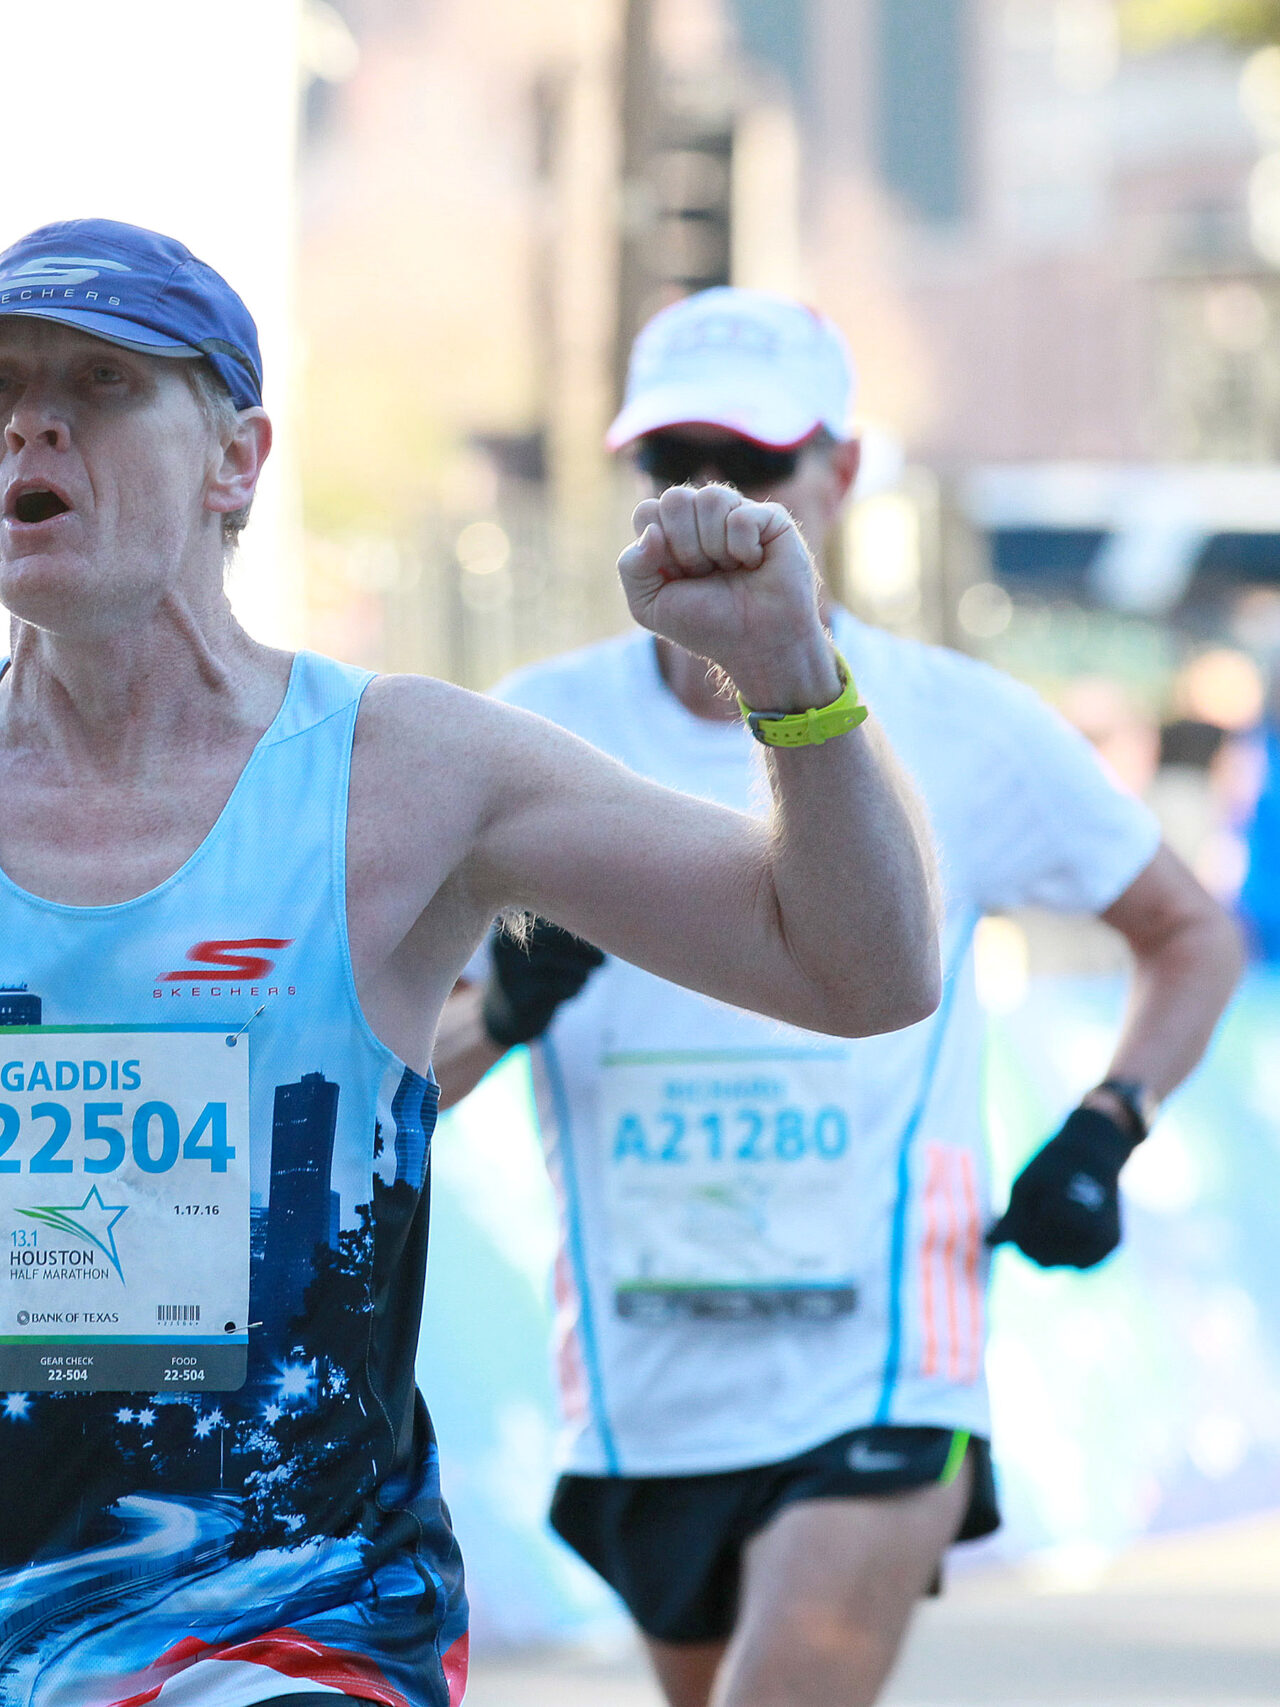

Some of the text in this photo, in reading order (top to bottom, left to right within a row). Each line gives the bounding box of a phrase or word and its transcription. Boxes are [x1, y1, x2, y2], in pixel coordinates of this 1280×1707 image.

[152, 986, 297, 999] SKECHERS
[0, 1060, 142, 1092] GADDIS
[612, 1104, 850, 1165] A21280
[173, 1204, 220, 1216] 1.17.16
[10, 1229, 38, 1247] 13.1
[10, 1250, 94, 1266] HOUSTON
[10, 1268, 109, 1280] HALF MARATHON
[31, 1312, 119, 1323] BANK OF TEXAS
[40, 1356, 94, 1366] GEAR CHECK
[171, 1356, 197, 1366] FOOD
[48, 1369, 88, 1381] 22-504
[164, 1369, 205, 1381] 22-504
